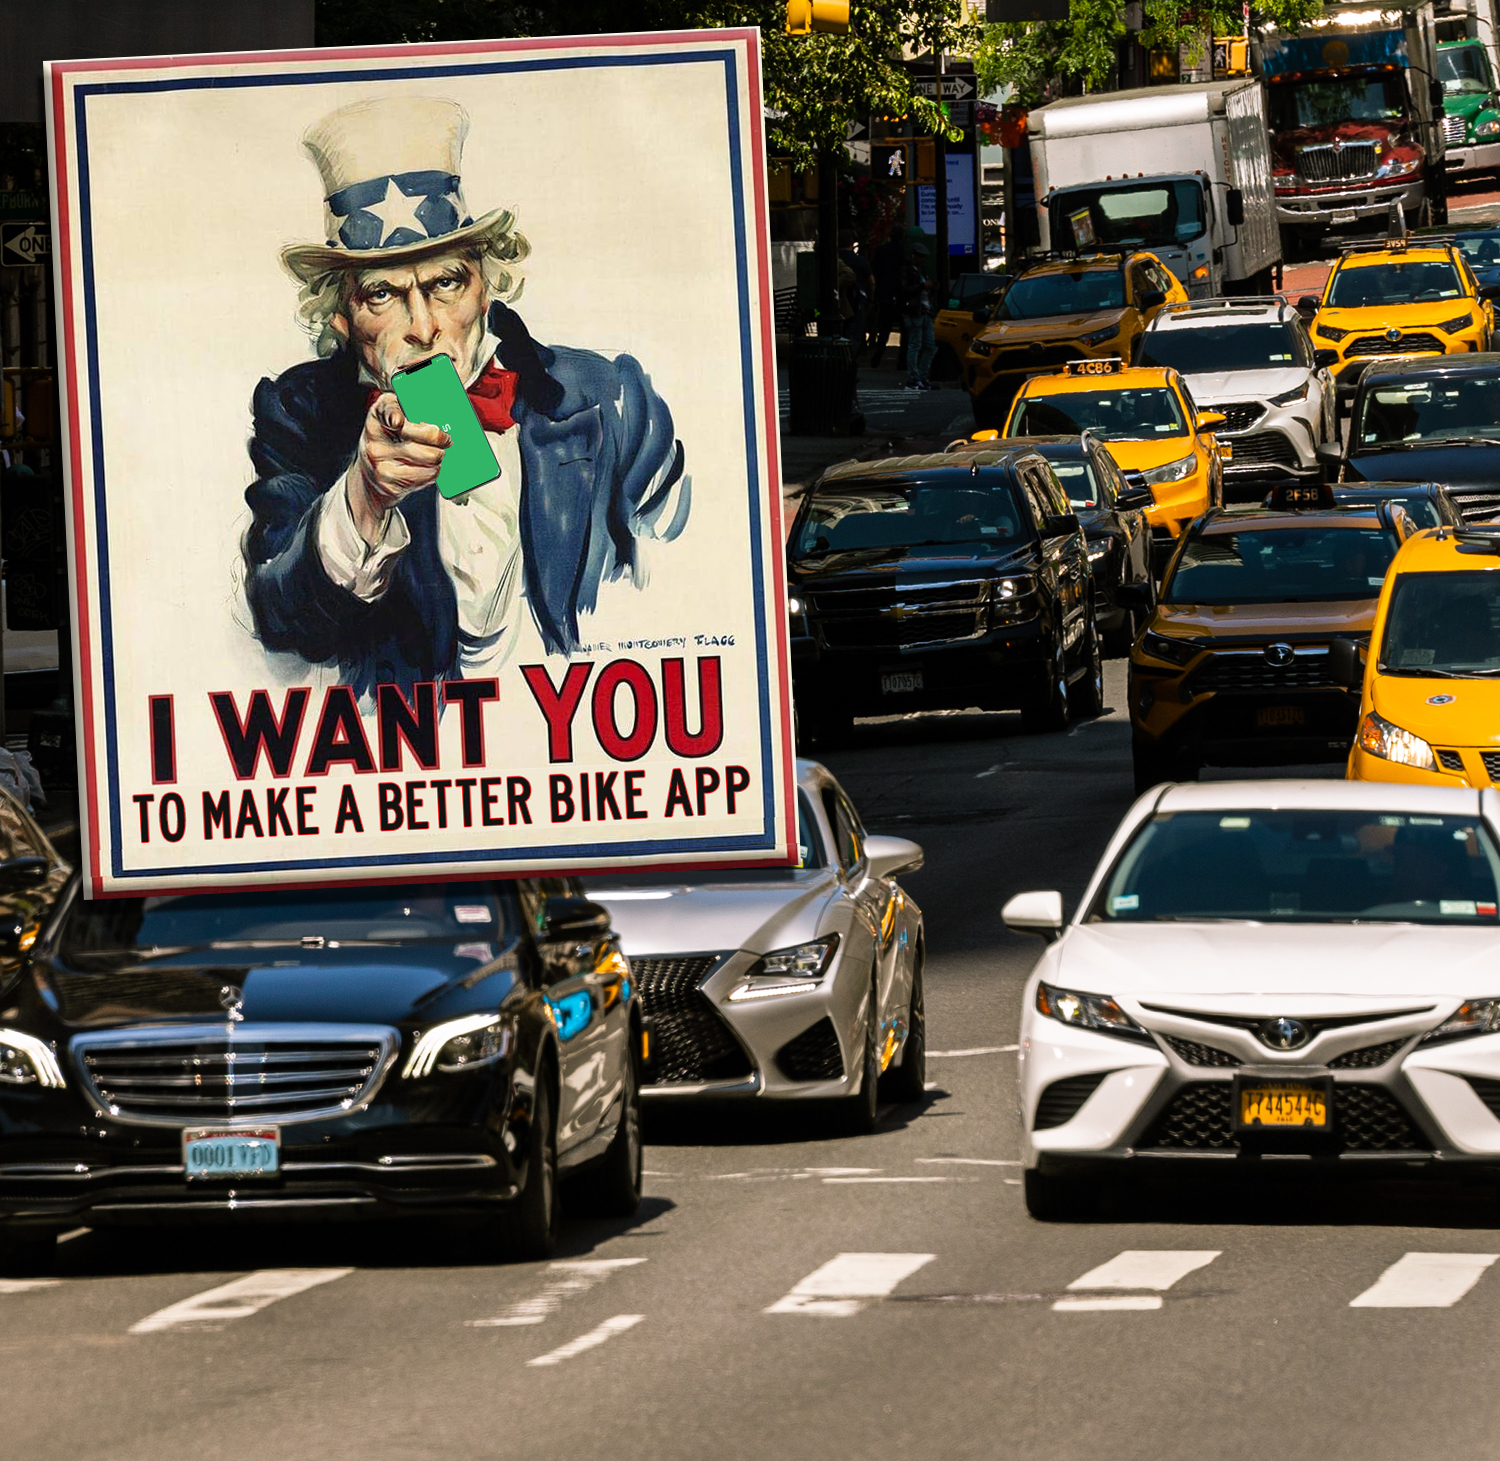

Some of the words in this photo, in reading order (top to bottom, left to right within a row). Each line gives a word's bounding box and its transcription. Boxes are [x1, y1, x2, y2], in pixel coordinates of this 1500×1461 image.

[942, 83, 967, 95] WAY
[1221, 136, 1231, 183] HEIGHT
[1077, 361, 1112, 374] 4C86
[1285, 488, 1319, 502] 2F58
[693, 633, 736, 648] FLAGG
[148, 694, 177, 785] I
[208, 676, 501, 781] WANT
[519, 655, 725, 764] YOU
[132, 791, 186, 844] TO
[202, 785, 320, 841] MAKE
[334, 783, 365, 834] A
[378, 774, 533, 832] BETTER
[549, 769, 649, 824] BIKE
[664, 764, 751, 818] APP
